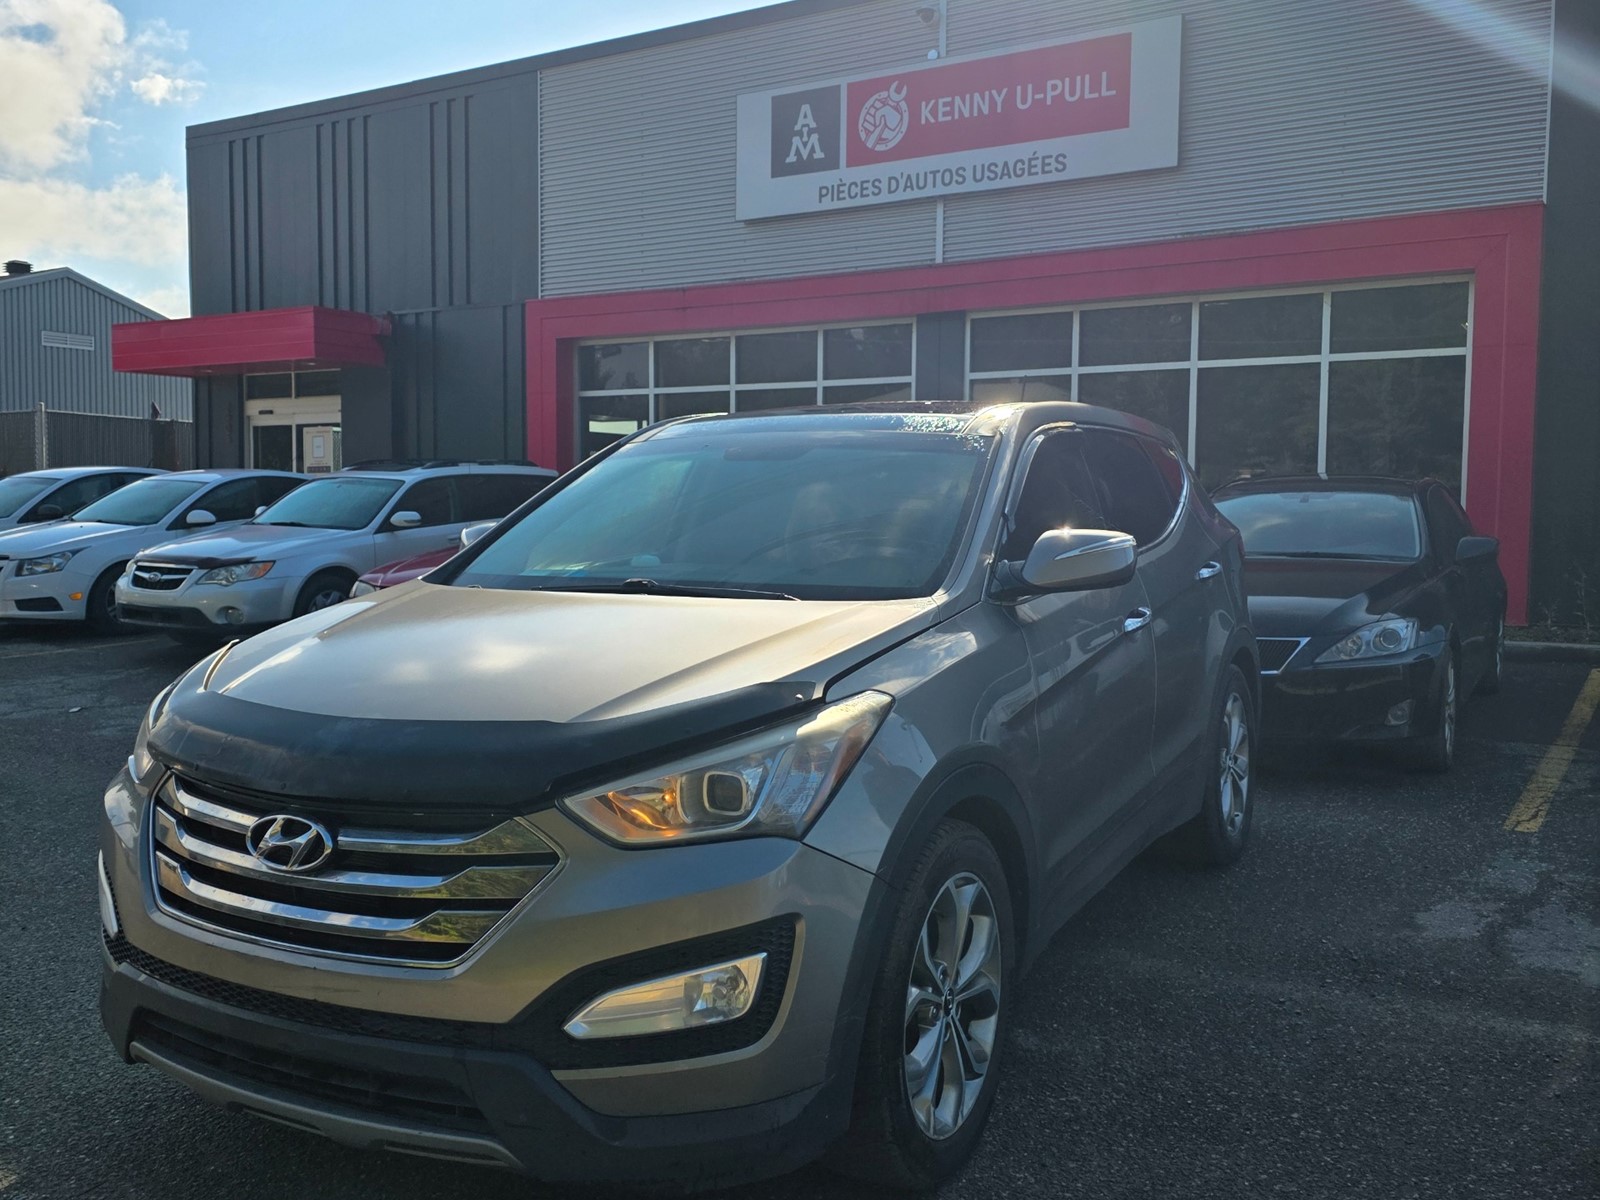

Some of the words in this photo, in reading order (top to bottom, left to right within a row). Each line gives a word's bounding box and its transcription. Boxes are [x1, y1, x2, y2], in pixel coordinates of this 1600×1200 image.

[920, 88, 1008, 125] KENNY
[1016, 71, 1116, 110] U-PULL
[818, 178, 882, 203] PIÈCES
[887, 166, 966, 194] D'AUTOS
[972, 151, 1068, 183] USAGÉES
